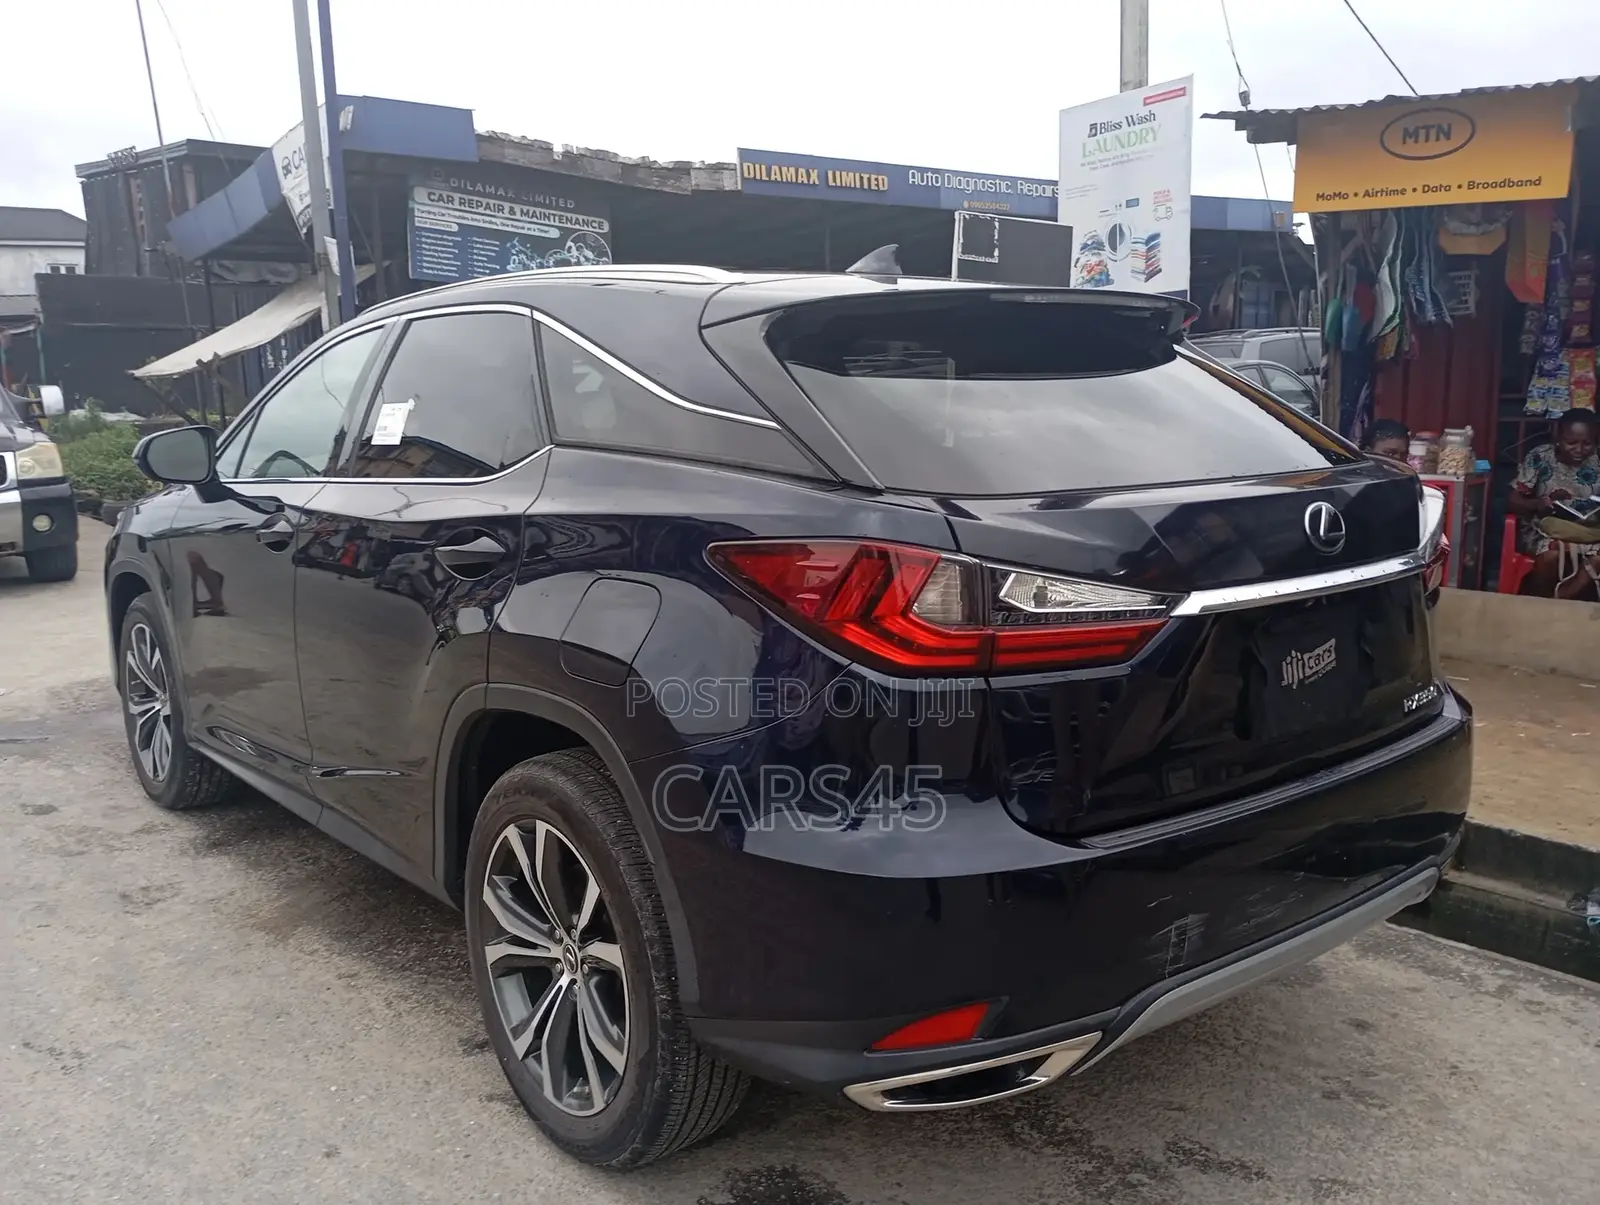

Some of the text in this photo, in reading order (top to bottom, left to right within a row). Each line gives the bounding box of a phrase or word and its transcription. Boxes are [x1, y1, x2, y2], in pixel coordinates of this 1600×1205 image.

[1099, 109, 1156, 135] Bliss Wash
[1402, 122, 1453, 145] MTN
[1082, 123, 1162, 158] LAUNDRY
[450, 178, 516, 198] DILAMAX
[742, 162, 889, 191] DILAMAX LIMITED
[908, 169, 941, 187] Auto
[1316, 176, 1542, 202] MoMo Airtime Data Broadband
[427, 191, 605, 231] CAR REPAIR & MAINTENANCE
